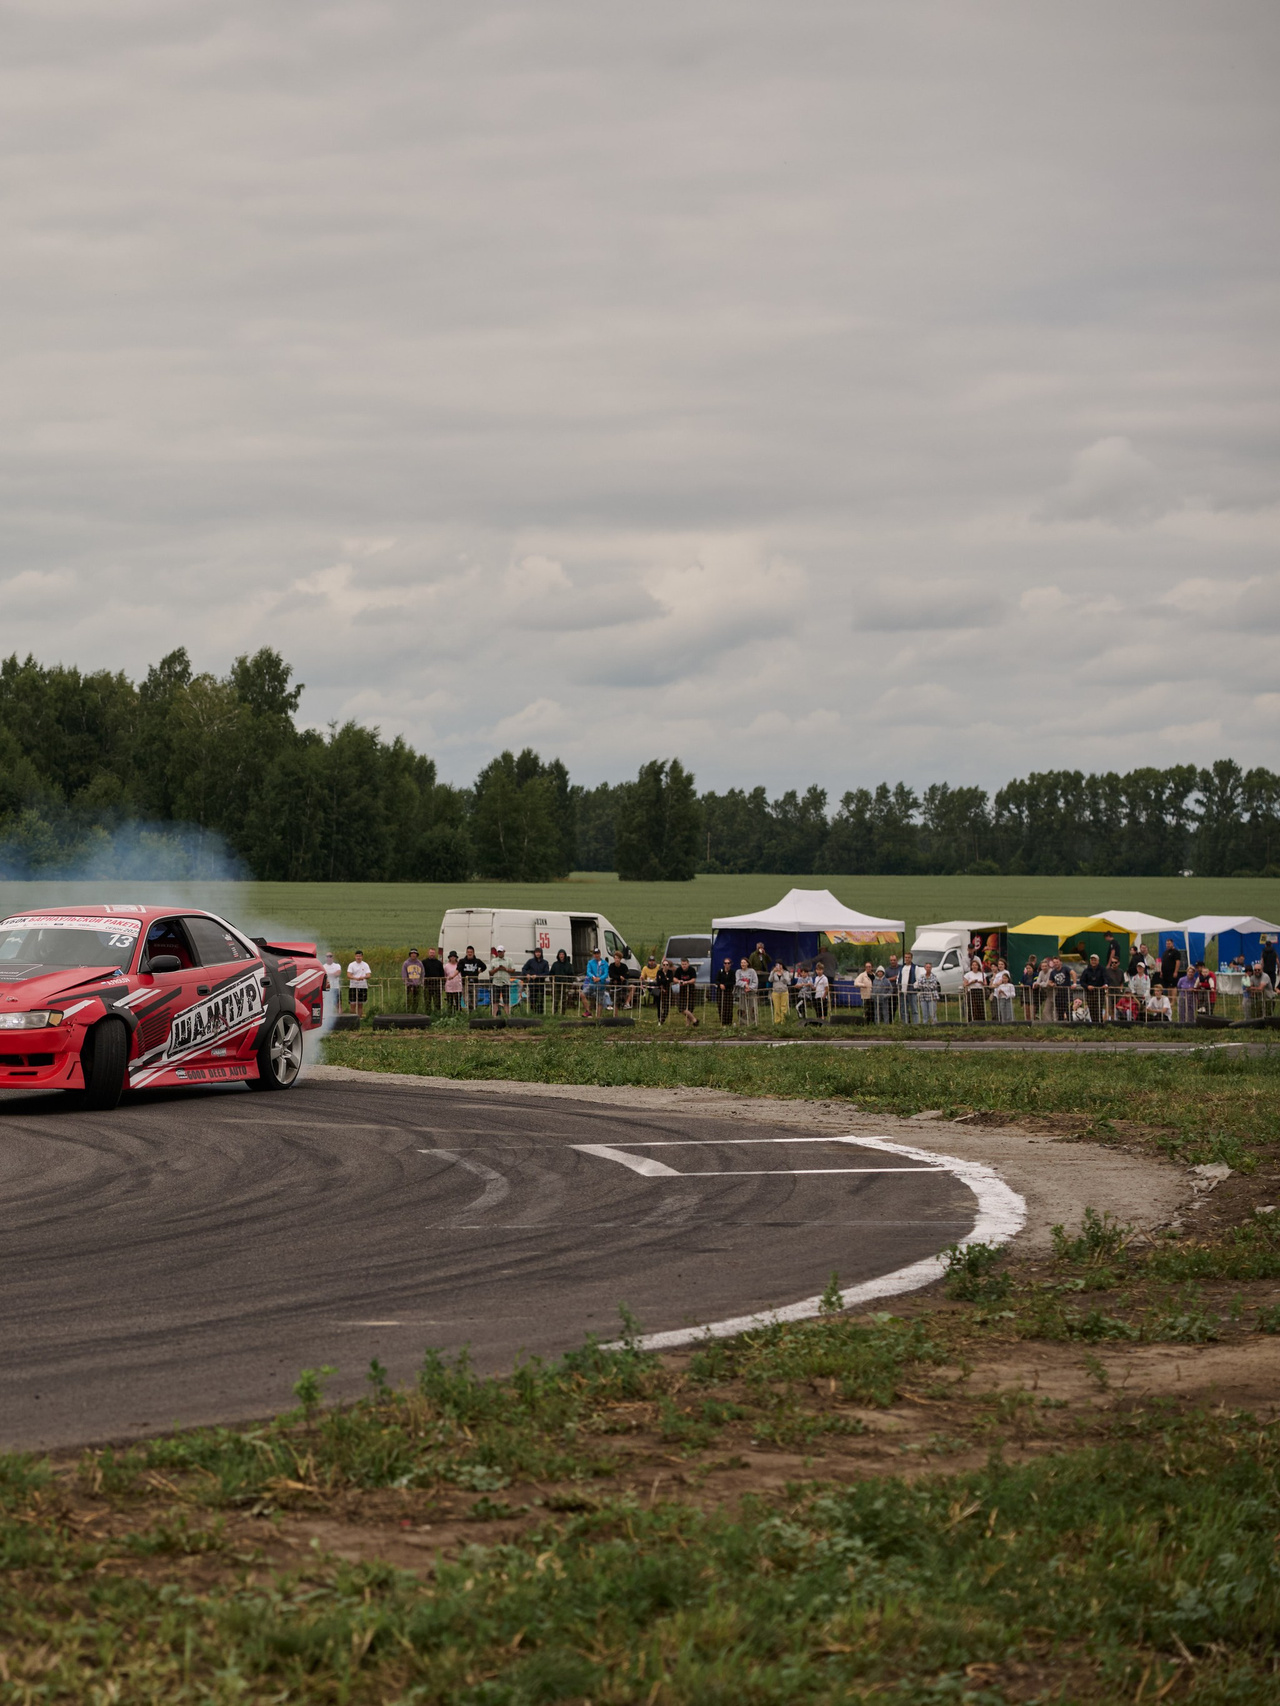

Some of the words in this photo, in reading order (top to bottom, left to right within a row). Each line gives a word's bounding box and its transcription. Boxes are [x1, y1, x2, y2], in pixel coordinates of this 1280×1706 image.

[108, 933, 134, 948] 13
[173, 983, 257, 1050] ШАМПУР
[187, 1070, 207, 1080] GOOD
[208, 1068, 227, 1078] DEED
[229, 1066, 247, 1076] AUTO
